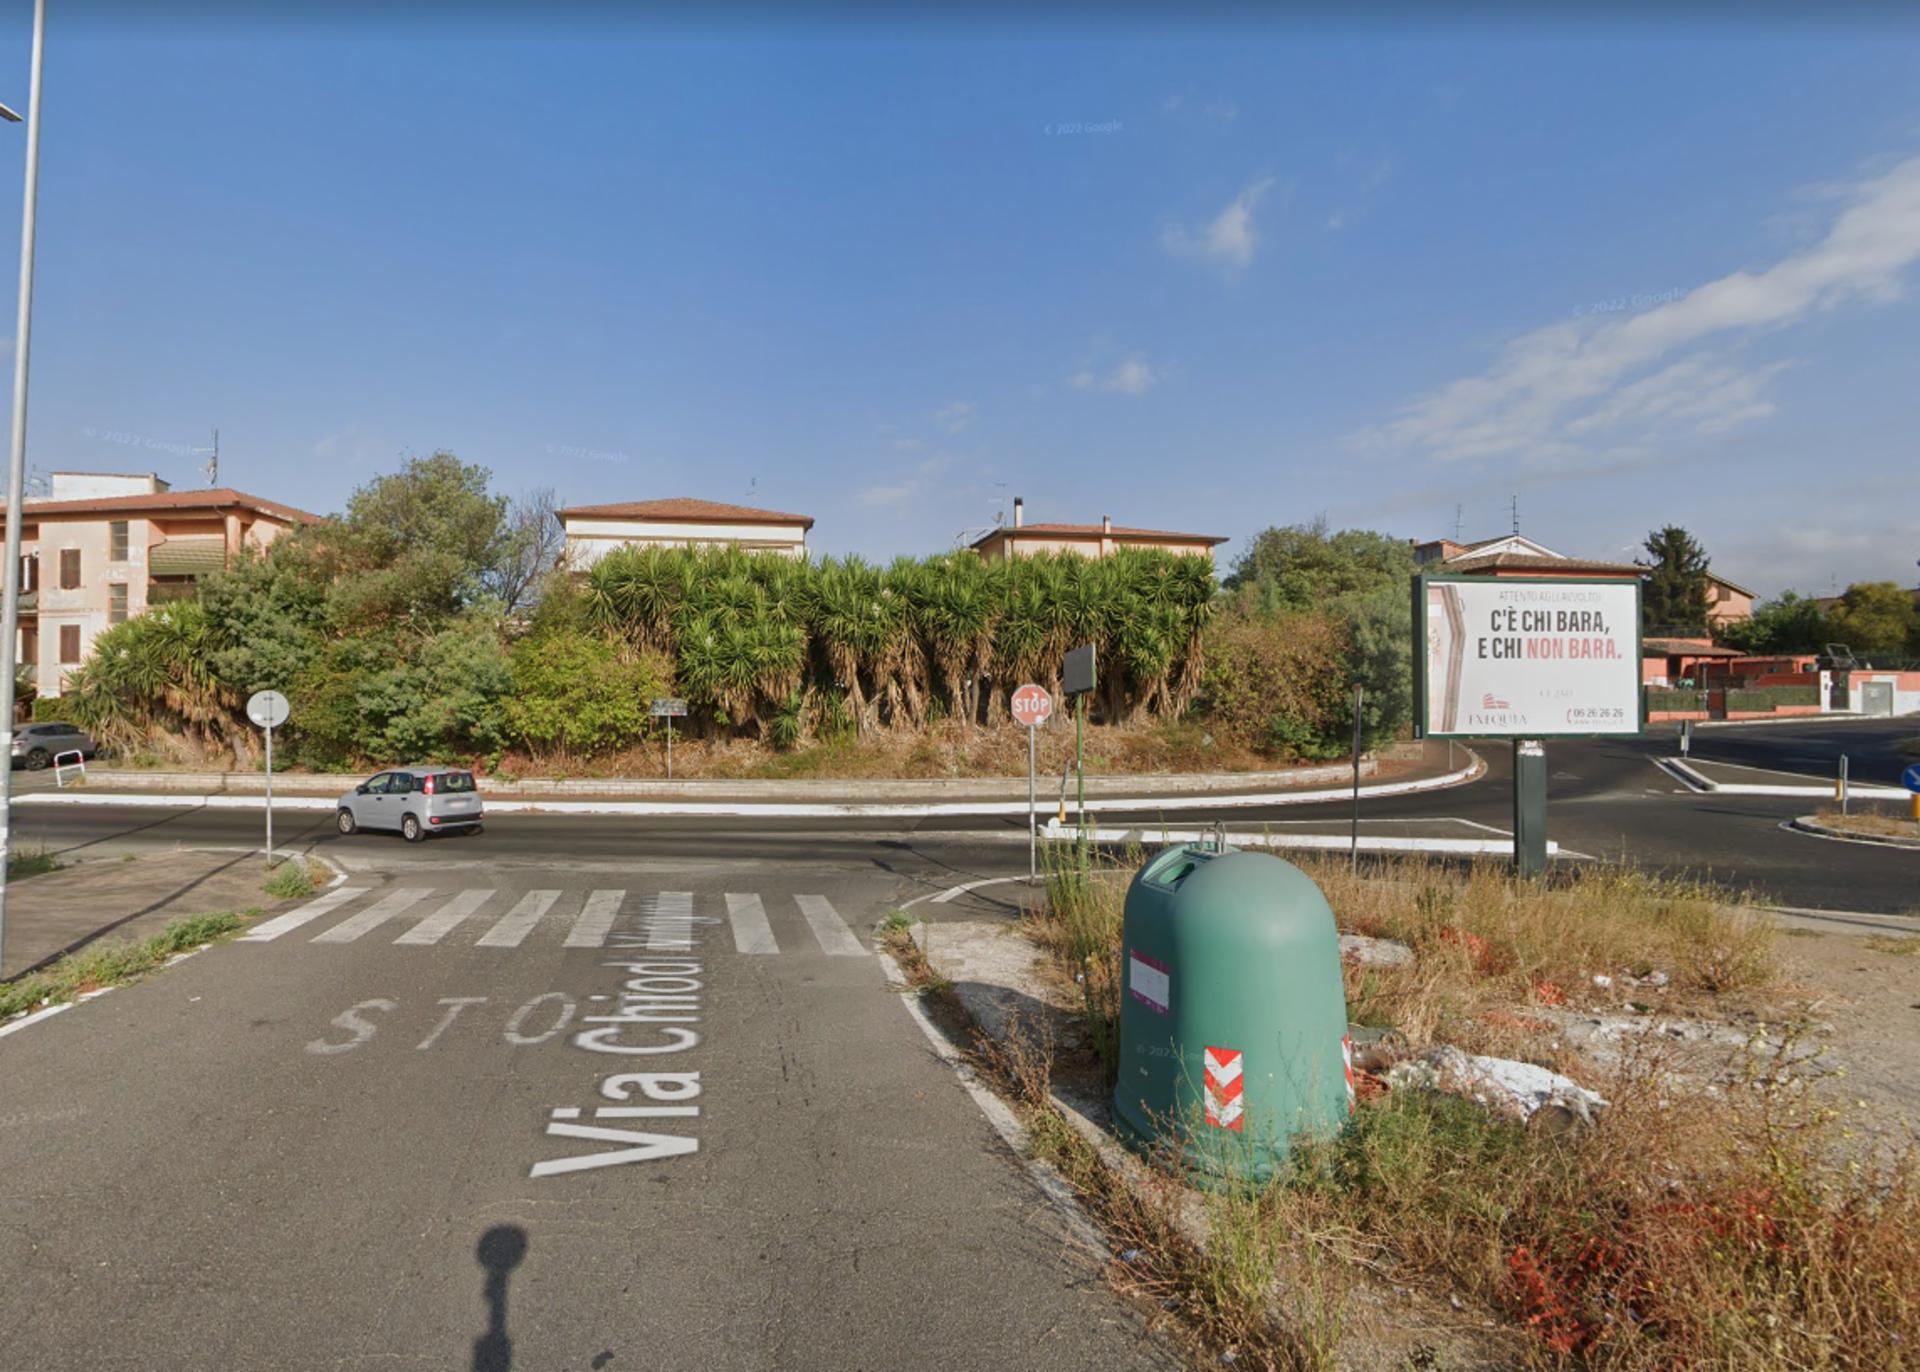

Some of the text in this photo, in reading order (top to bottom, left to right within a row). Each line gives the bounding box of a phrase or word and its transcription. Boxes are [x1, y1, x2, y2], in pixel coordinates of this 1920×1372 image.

[1522, 610, 1552, 632] CHI
[1556, 610, 1610, 634] BARA,
[1478, 637, 1622, 659] E CHI NON BARA.
[1014, 698, 1049, 713] STOP
